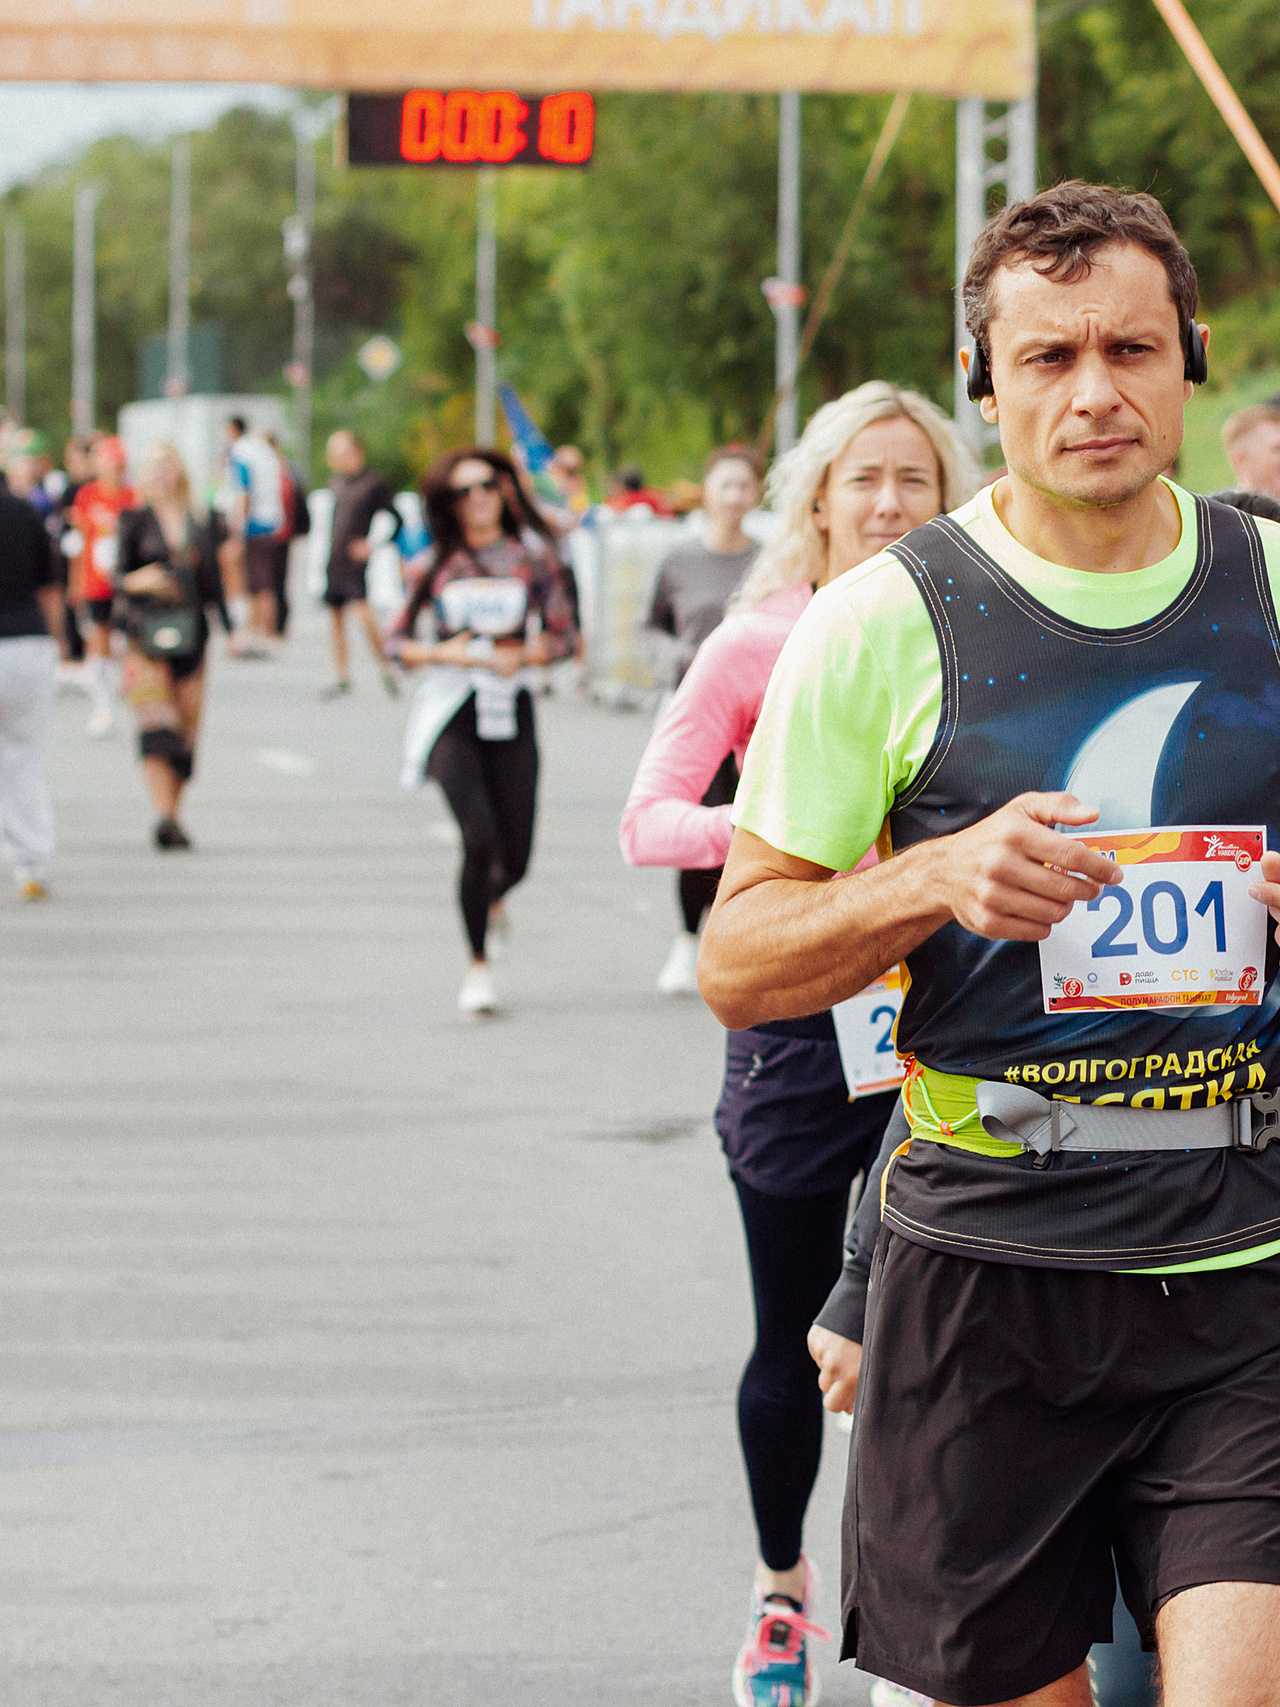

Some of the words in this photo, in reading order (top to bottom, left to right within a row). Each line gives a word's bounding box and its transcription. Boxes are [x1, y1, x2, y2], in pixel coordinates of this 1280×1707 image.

[1087, 881, 1227, 958] 201
[1171, 969, 1199, 981] СТС
[1121, 994, 1180, 1006] ПОЛУМАРАФОН
[1004, 1039, 1261, 1084] #ВОЛГОГРАДСКАЯ
